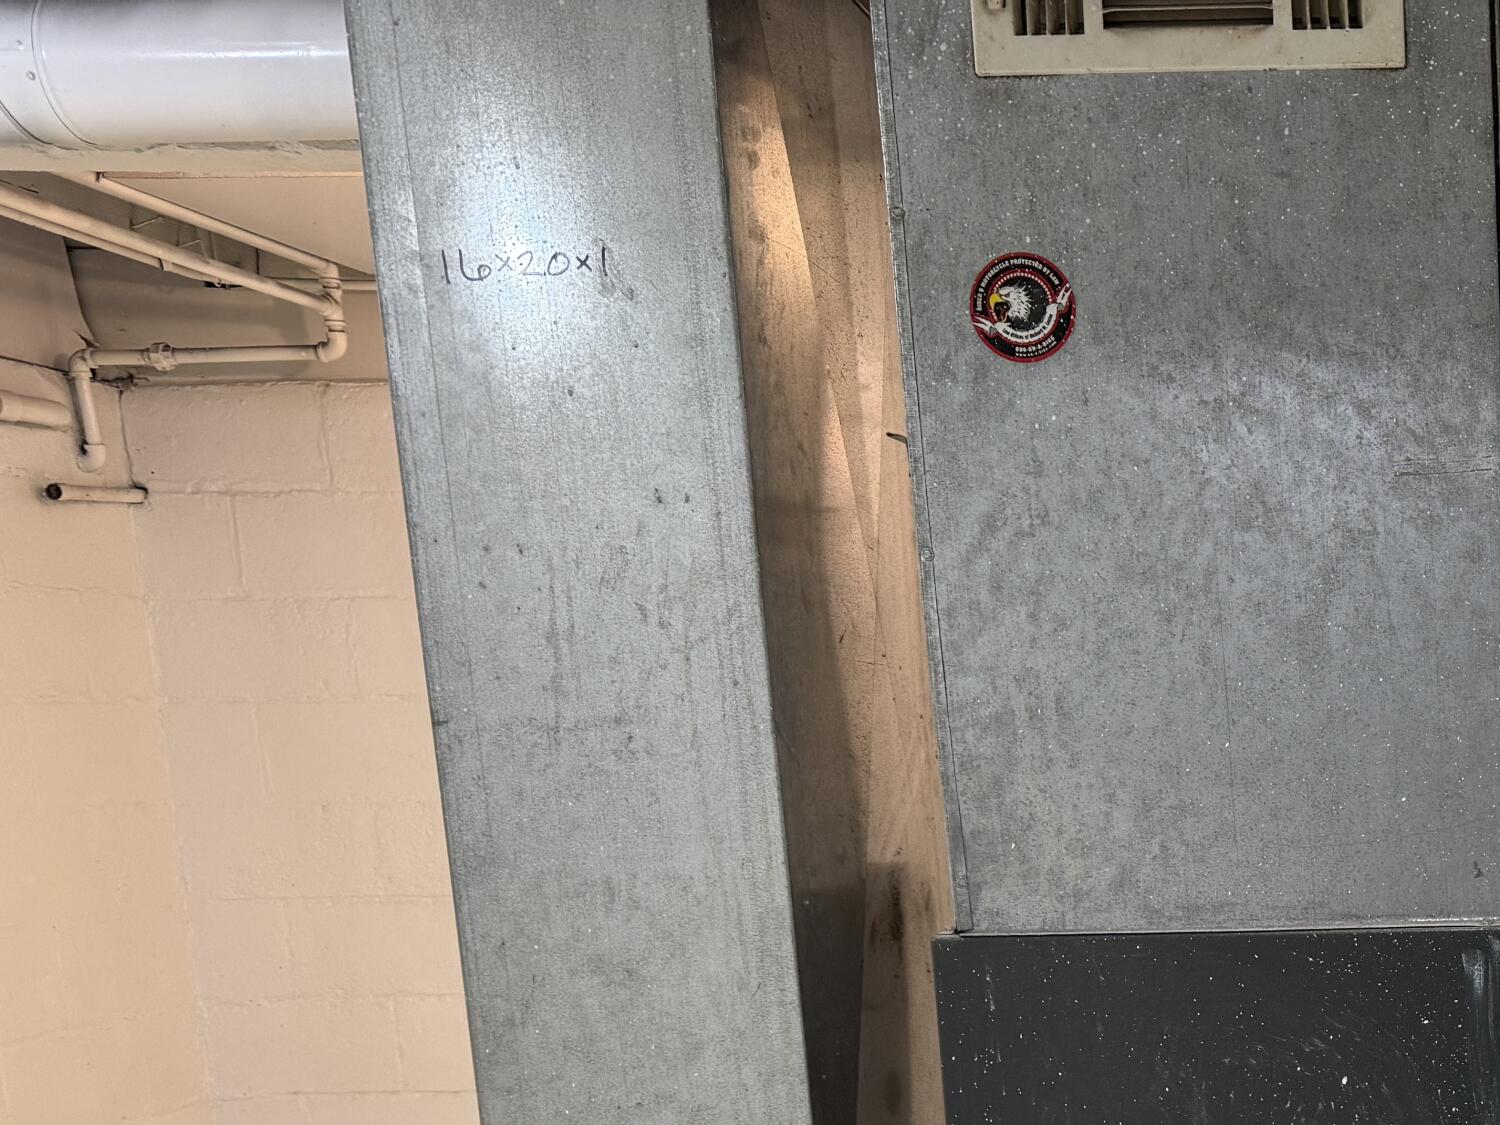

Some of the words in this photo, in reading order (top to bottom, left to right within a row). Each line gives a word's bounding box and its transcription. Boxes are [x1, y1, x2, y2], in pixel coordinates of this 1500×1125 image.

[981, 260, 1009, 288] MOTORCYCLE
[1010, 258, 1042, 269] PROTECTED
[1042, 265, 1050, 274] BY
